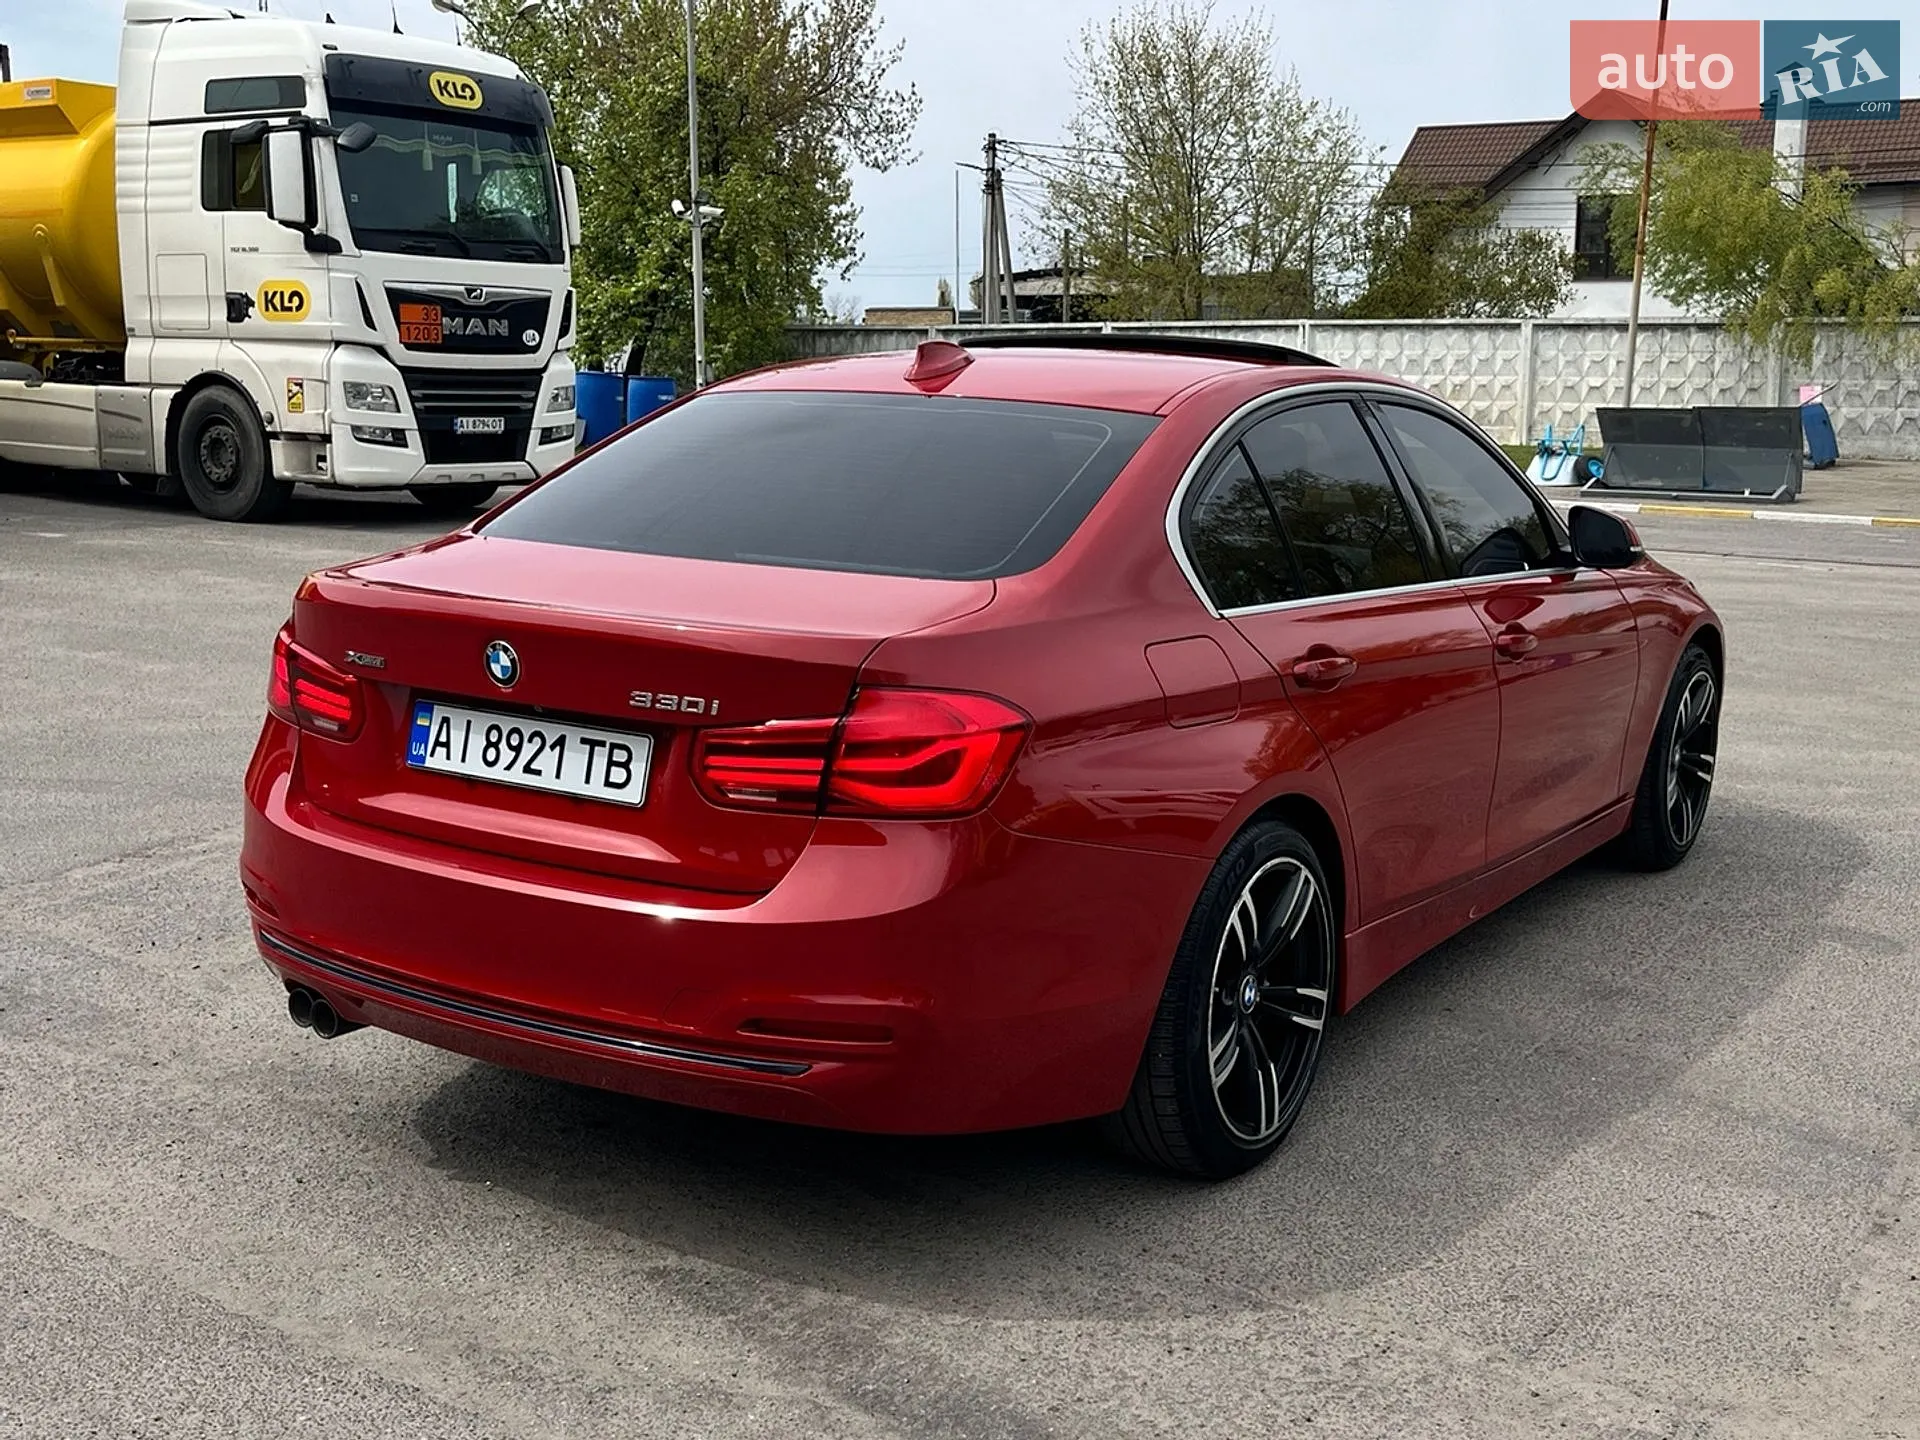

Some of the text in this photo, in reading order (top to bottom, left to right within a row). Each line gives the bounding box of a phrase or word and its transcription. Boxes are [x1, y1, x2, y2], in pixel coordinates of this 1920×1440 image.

[436, 79, 476, 101] KLO
[263, 290, 304, 313] KLO
[421, 306, 439, 322] 33
[405, 325, 440, 341] 1203
[442, 316, 509, 337] MAN
[525, 334, 537, 344] UA
[629, 690, 720, 716] 330i
[412, 740, 426, 757] UA
[429, 715, 633, 790] AI 8921 TB
